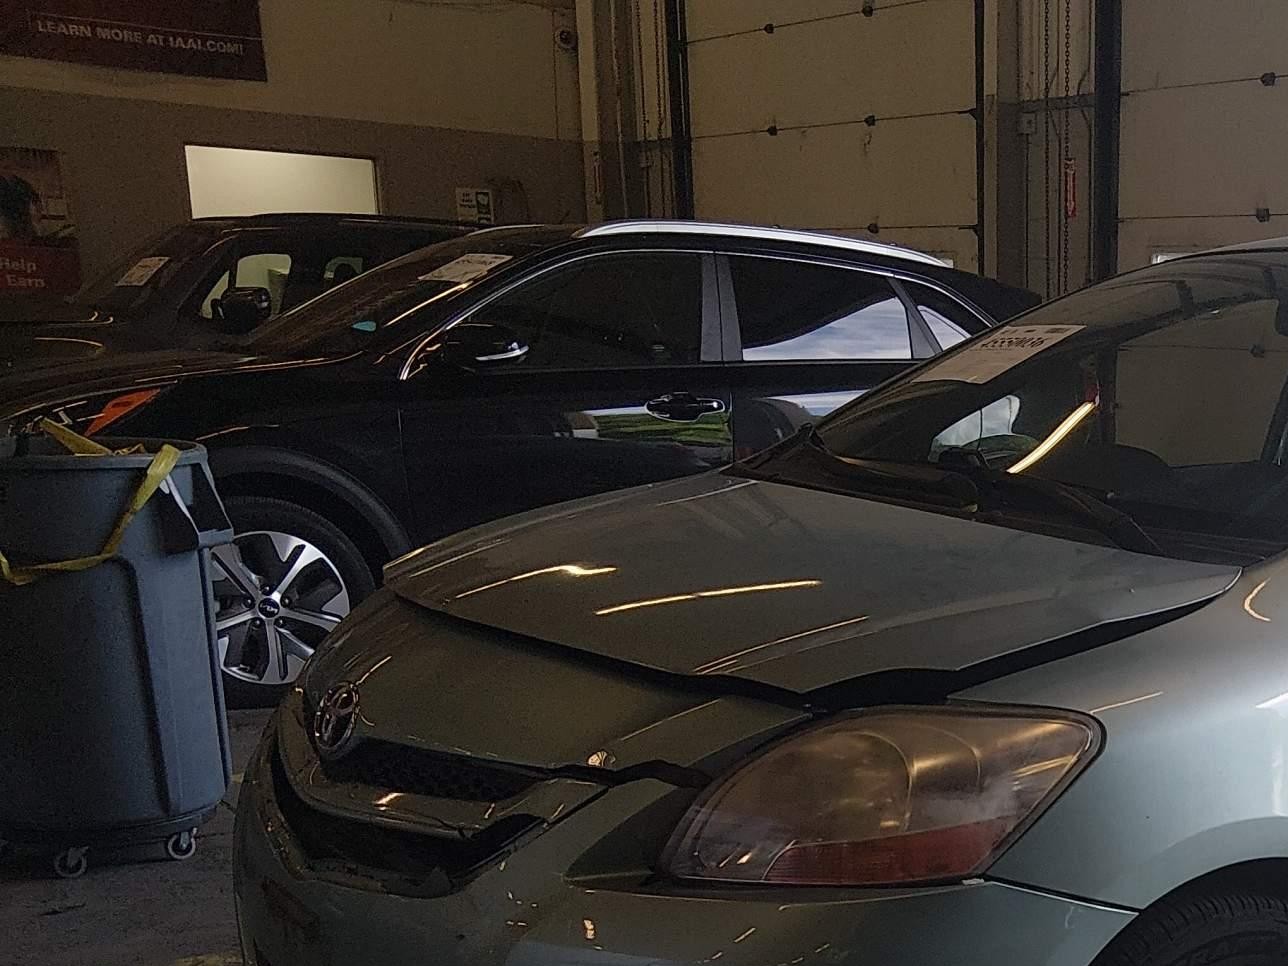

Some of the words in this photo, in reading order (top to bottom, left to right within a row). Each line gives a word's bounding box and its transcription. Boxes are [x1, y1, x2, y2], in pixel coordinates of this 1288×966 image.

[37, 20, 92, 38] LEARN
[97, 26, 142, 44] MORE
[146, 34, 169, 47] AT
